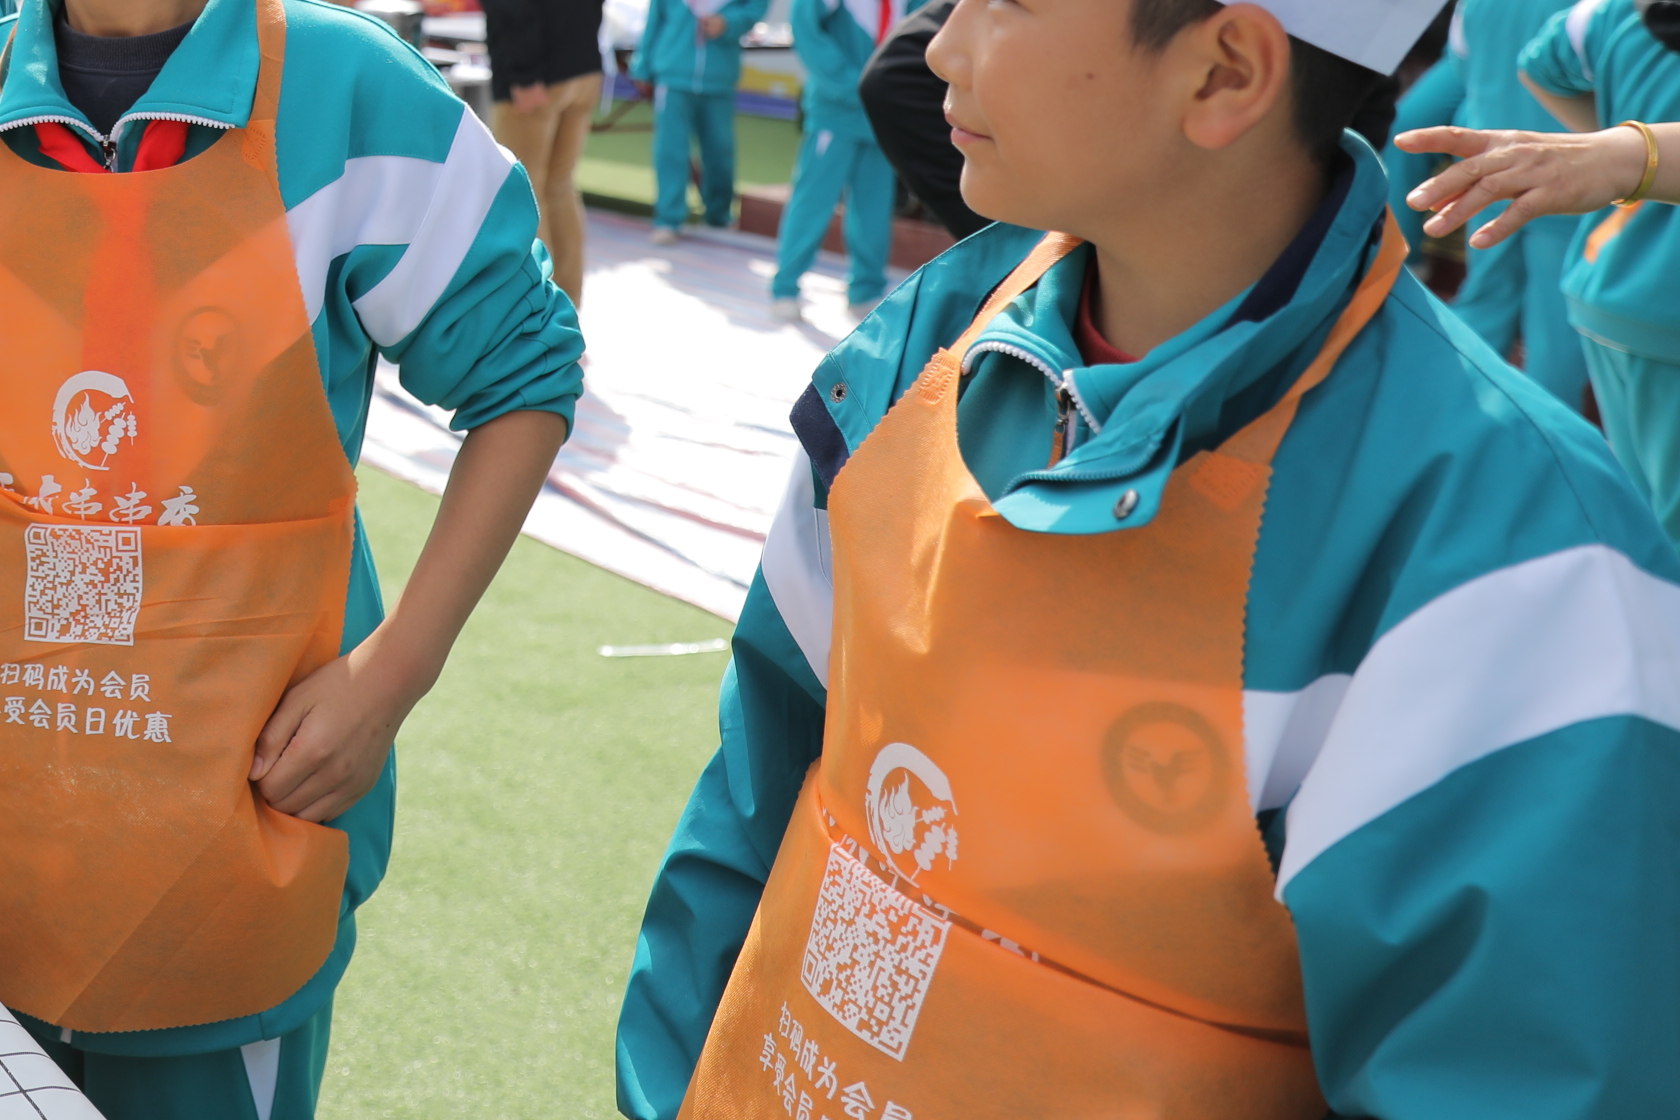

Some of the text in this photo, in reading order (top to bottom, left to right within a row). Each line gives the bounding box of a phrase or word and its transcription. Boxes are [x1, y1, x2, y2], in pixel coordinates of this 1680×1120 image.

[0, 663, 151, 702] 扫码成为会员
[759, 1032, 829, 1120] 享受会员
